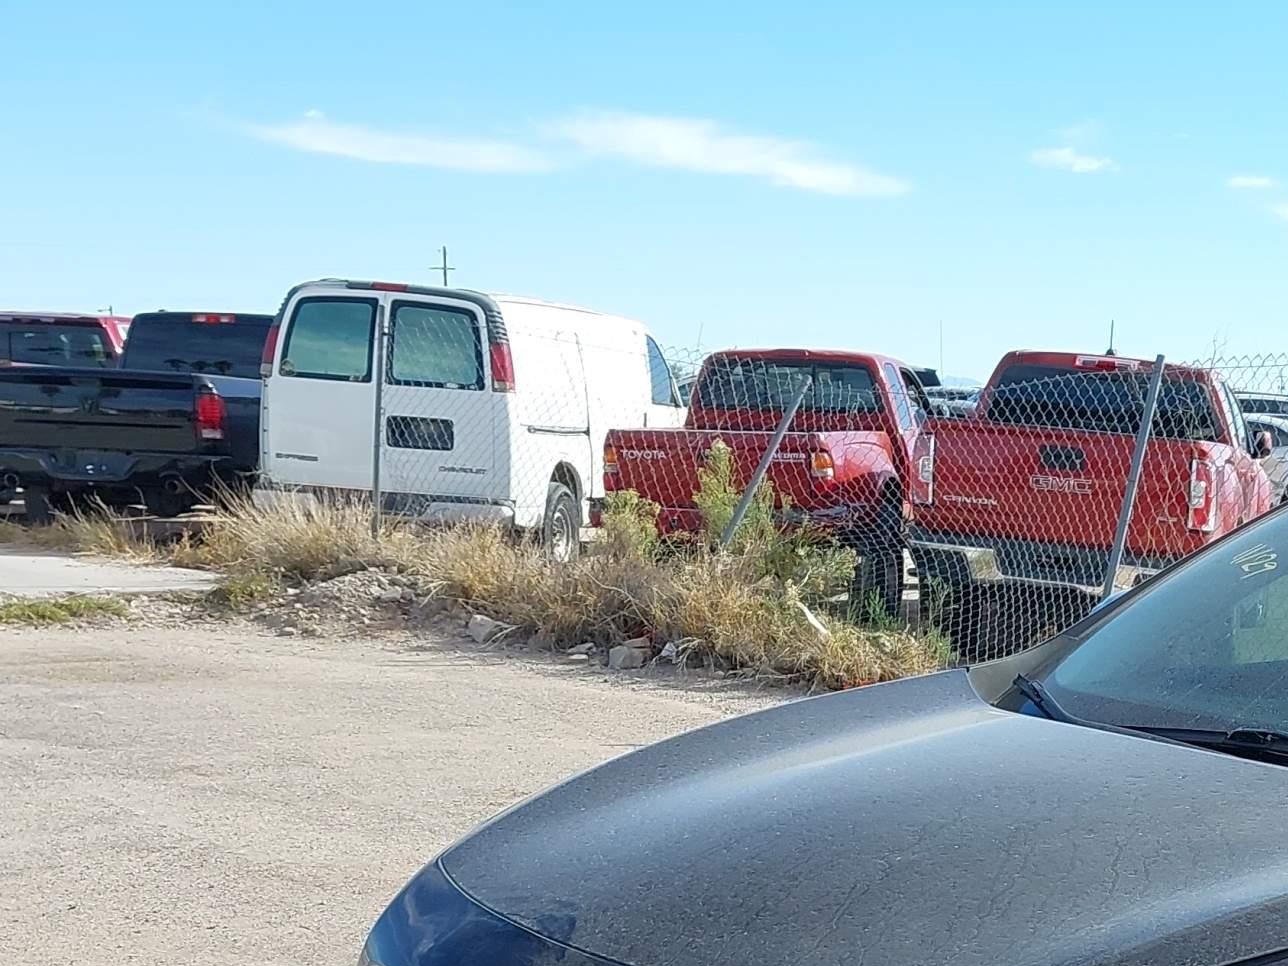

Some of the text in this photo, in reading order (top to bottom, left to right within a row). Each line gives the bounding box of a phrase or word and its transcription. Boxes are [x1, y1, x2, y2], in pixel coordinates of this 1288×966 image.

[621, 450, 667, 459] TOYOTA
[1030, 475, 1092, 494] GMC
[943, 495, 998, 505] CANYON
